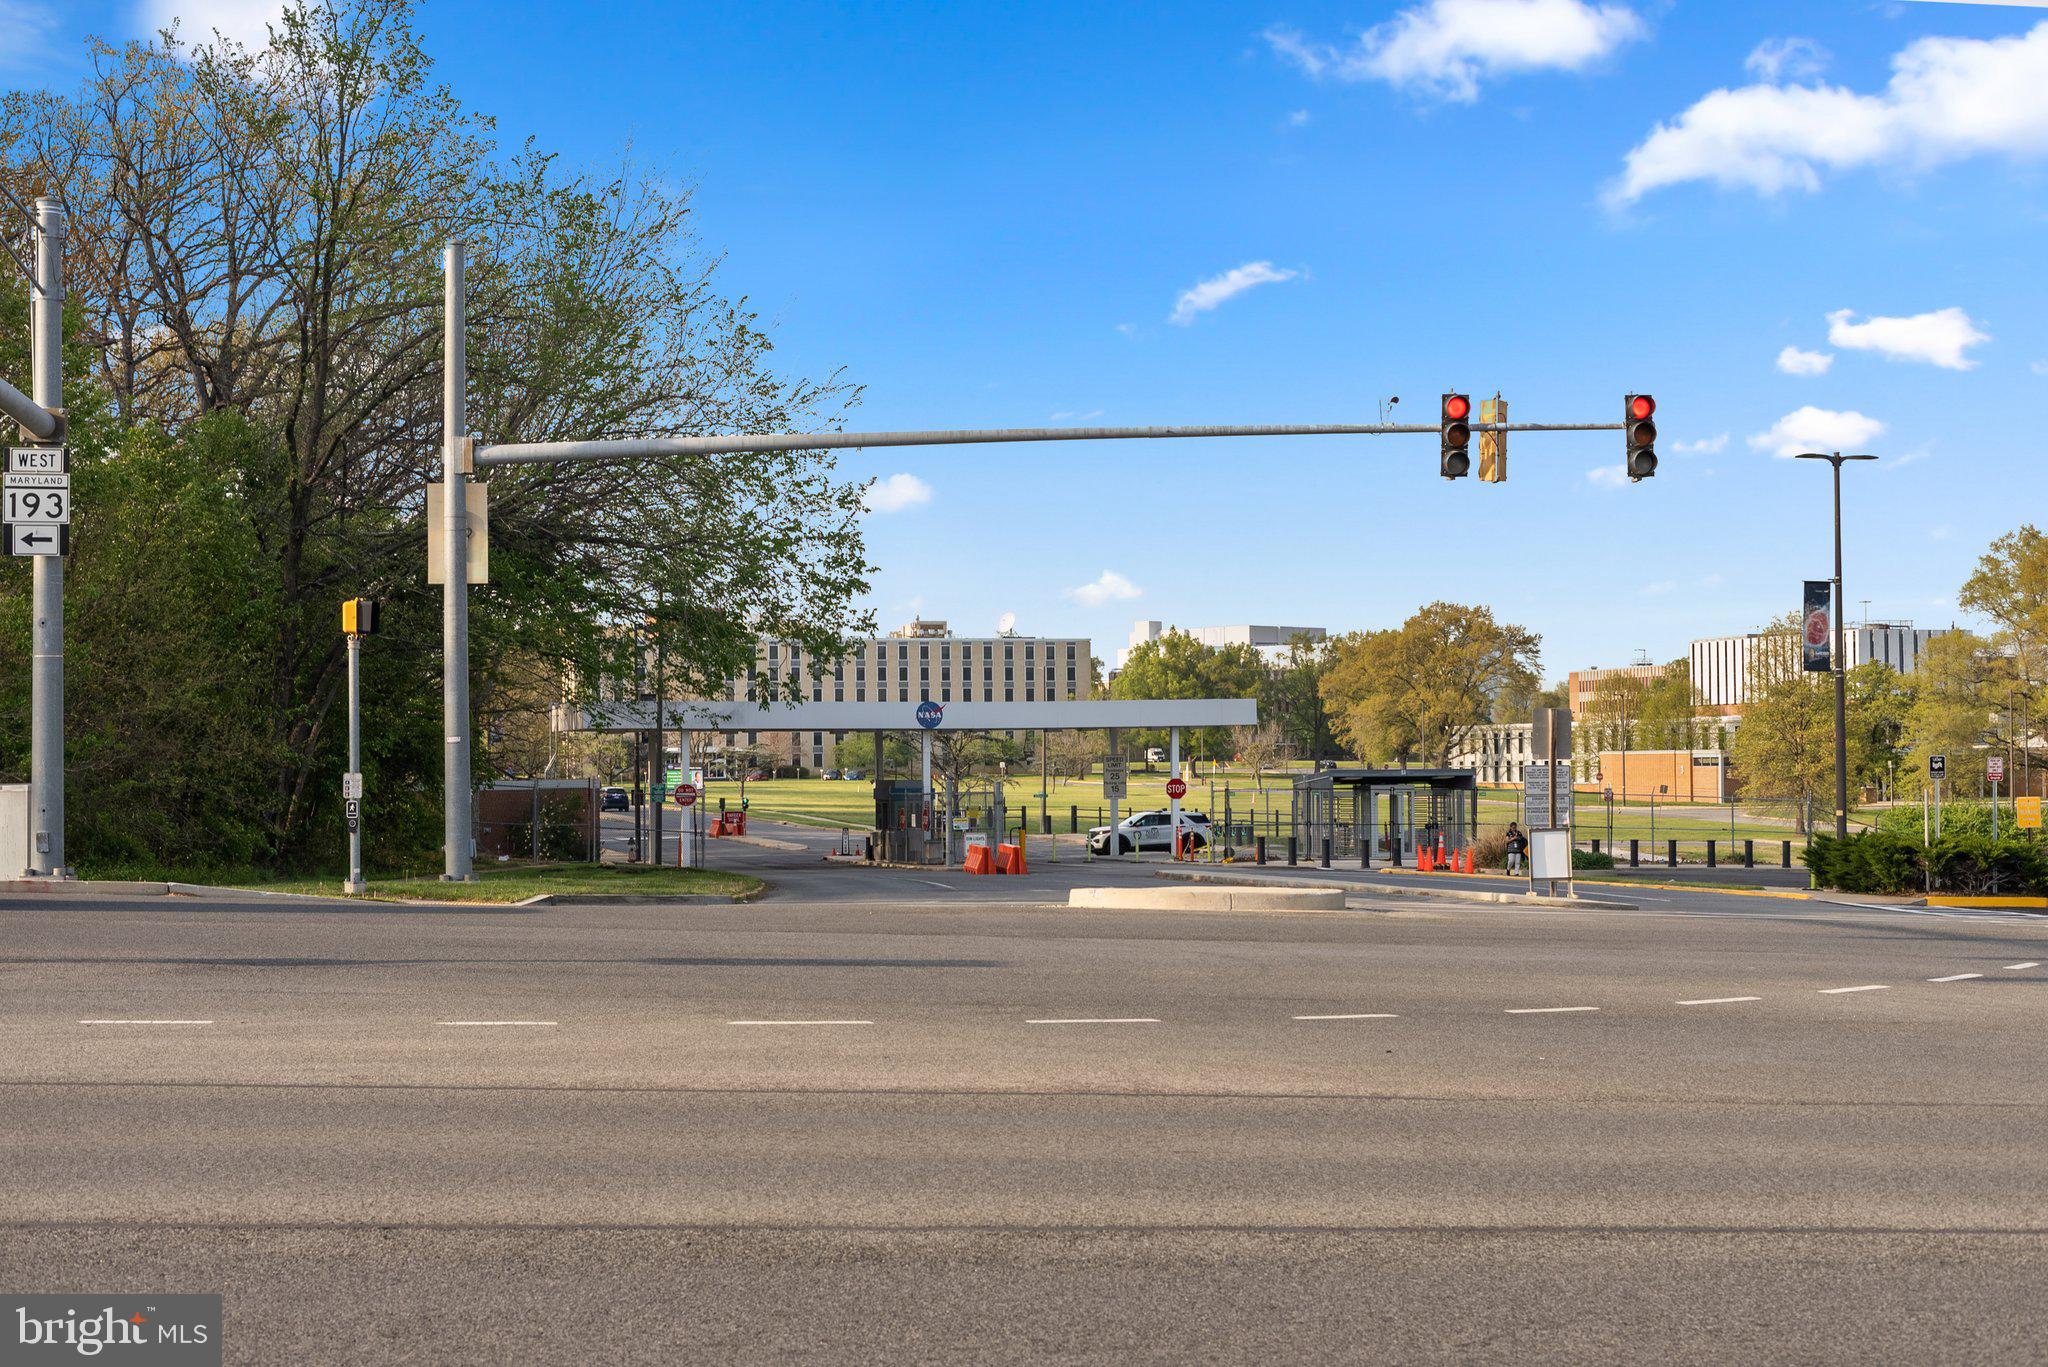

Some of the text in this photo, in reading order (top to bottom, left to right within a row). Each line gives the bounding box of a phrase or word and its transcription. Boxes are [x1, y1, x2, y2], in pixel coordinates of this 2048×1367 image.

[18, 454, 56, 467] WEST
[10, 477, 63, 485] MARYLAND
[9, 492, 63, 518] 193
[918, 711, 942, 719] NASA
[1111, 785, 1120, 793] 15
[1167, 784, 1186, 794] STOP
